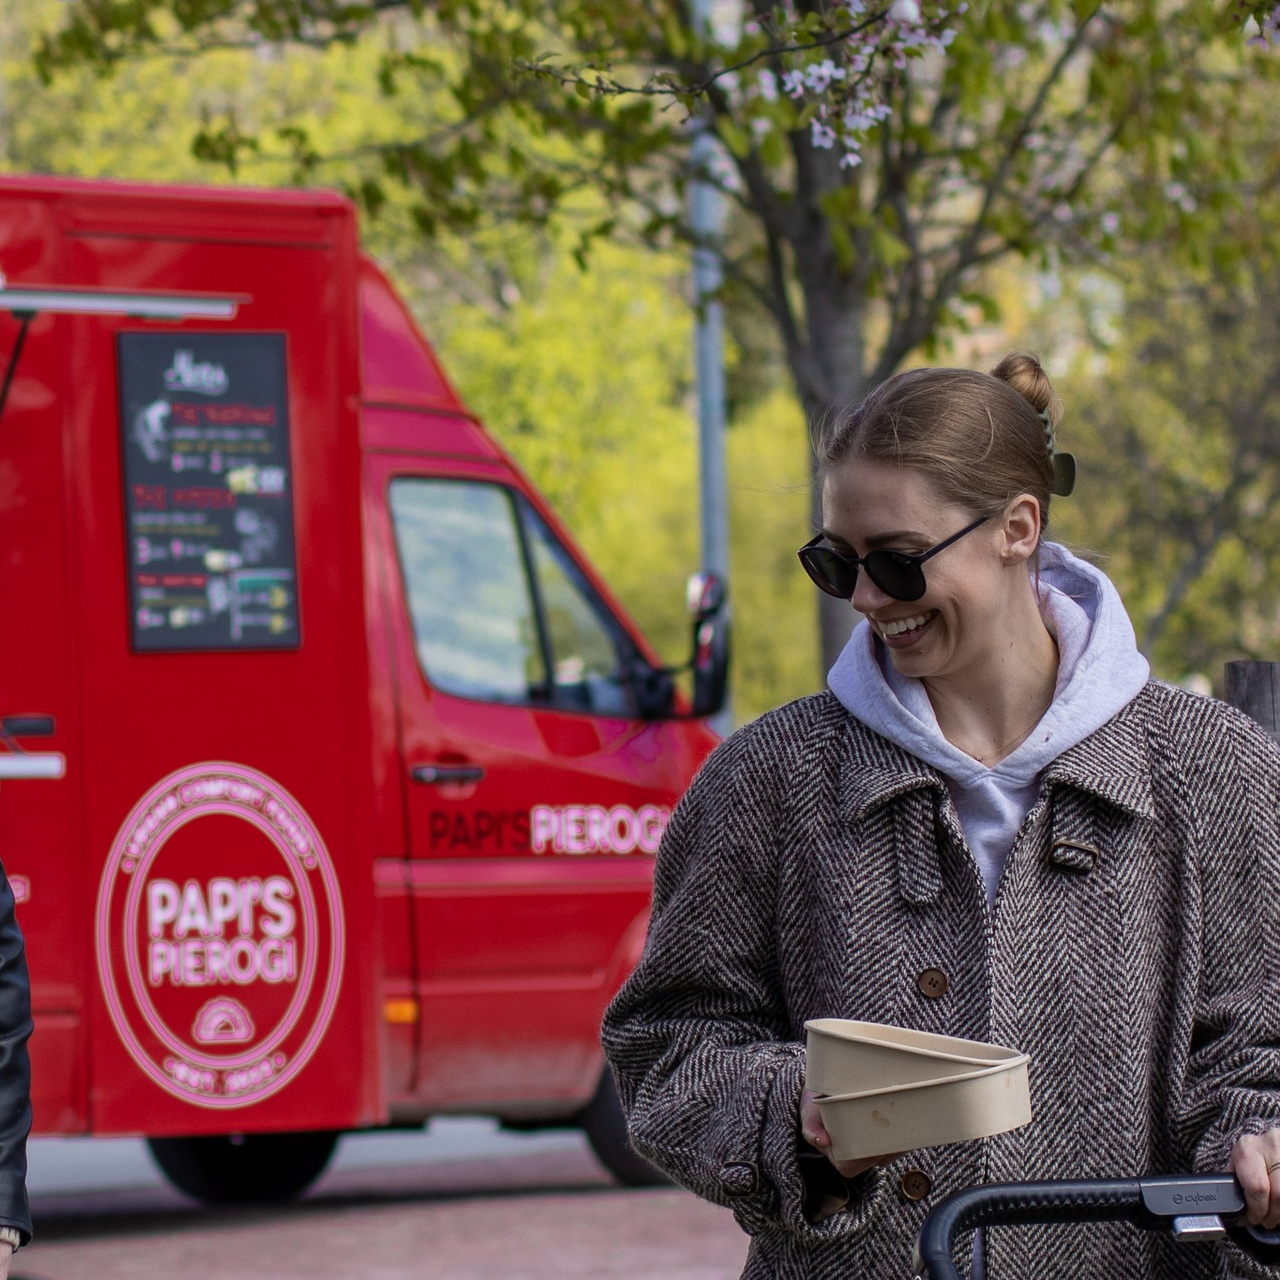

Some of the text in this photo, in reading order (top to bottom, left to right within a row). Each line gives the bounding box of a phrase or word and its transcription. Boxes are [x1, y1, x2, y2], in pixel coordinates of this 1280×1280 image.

[430, 810, 530, 852] PAPI'S
[149, 879, 295, 937] PAPI'S
[150, 939, 295, 985] PIEROGI
[1184, 1190, 1218, 1205] cybex
